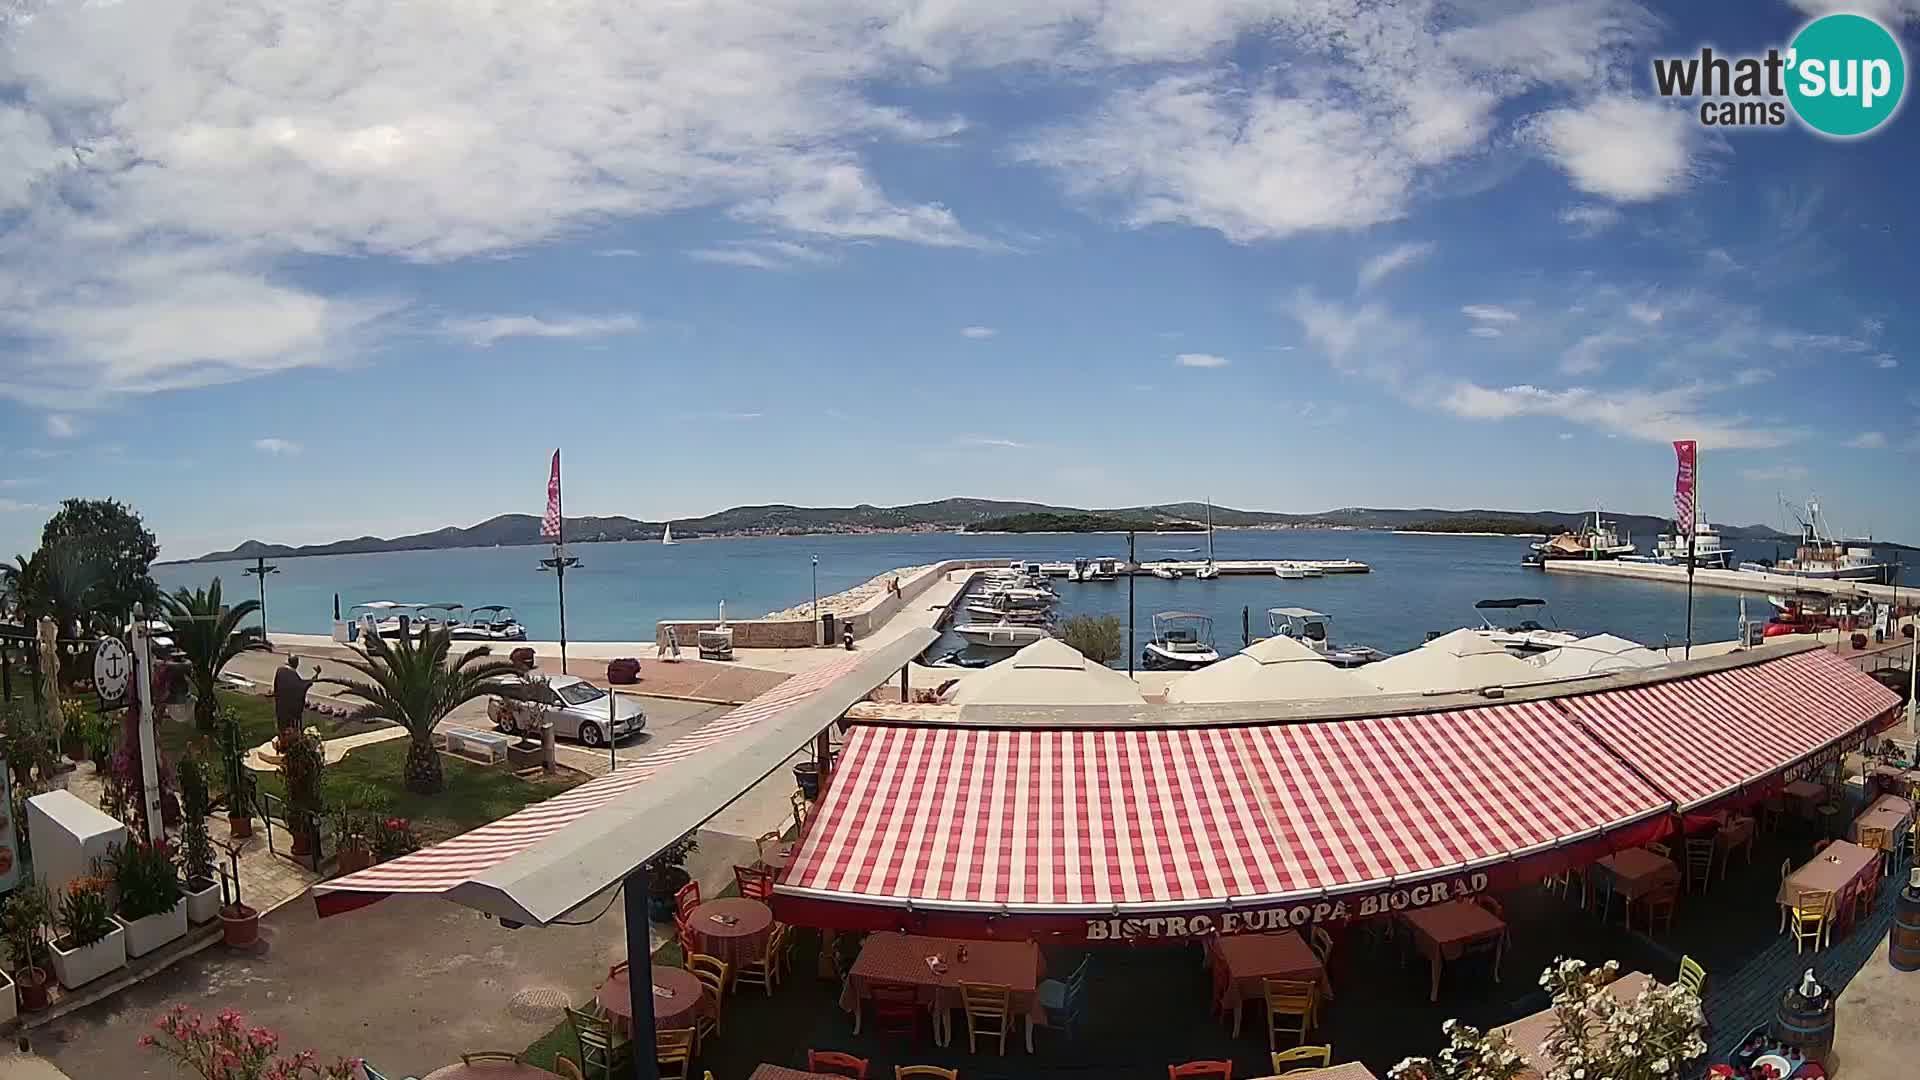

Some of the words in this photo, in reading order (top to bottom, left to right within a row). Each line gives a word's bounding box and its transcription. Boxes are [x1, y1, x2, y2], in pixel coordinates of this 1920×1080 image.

[1086, 915, 1213, 940] BISTRO
[1221, 901, 1352, 933] EUROPA
[1360, 872, 1488, 916] BIOGRAD
